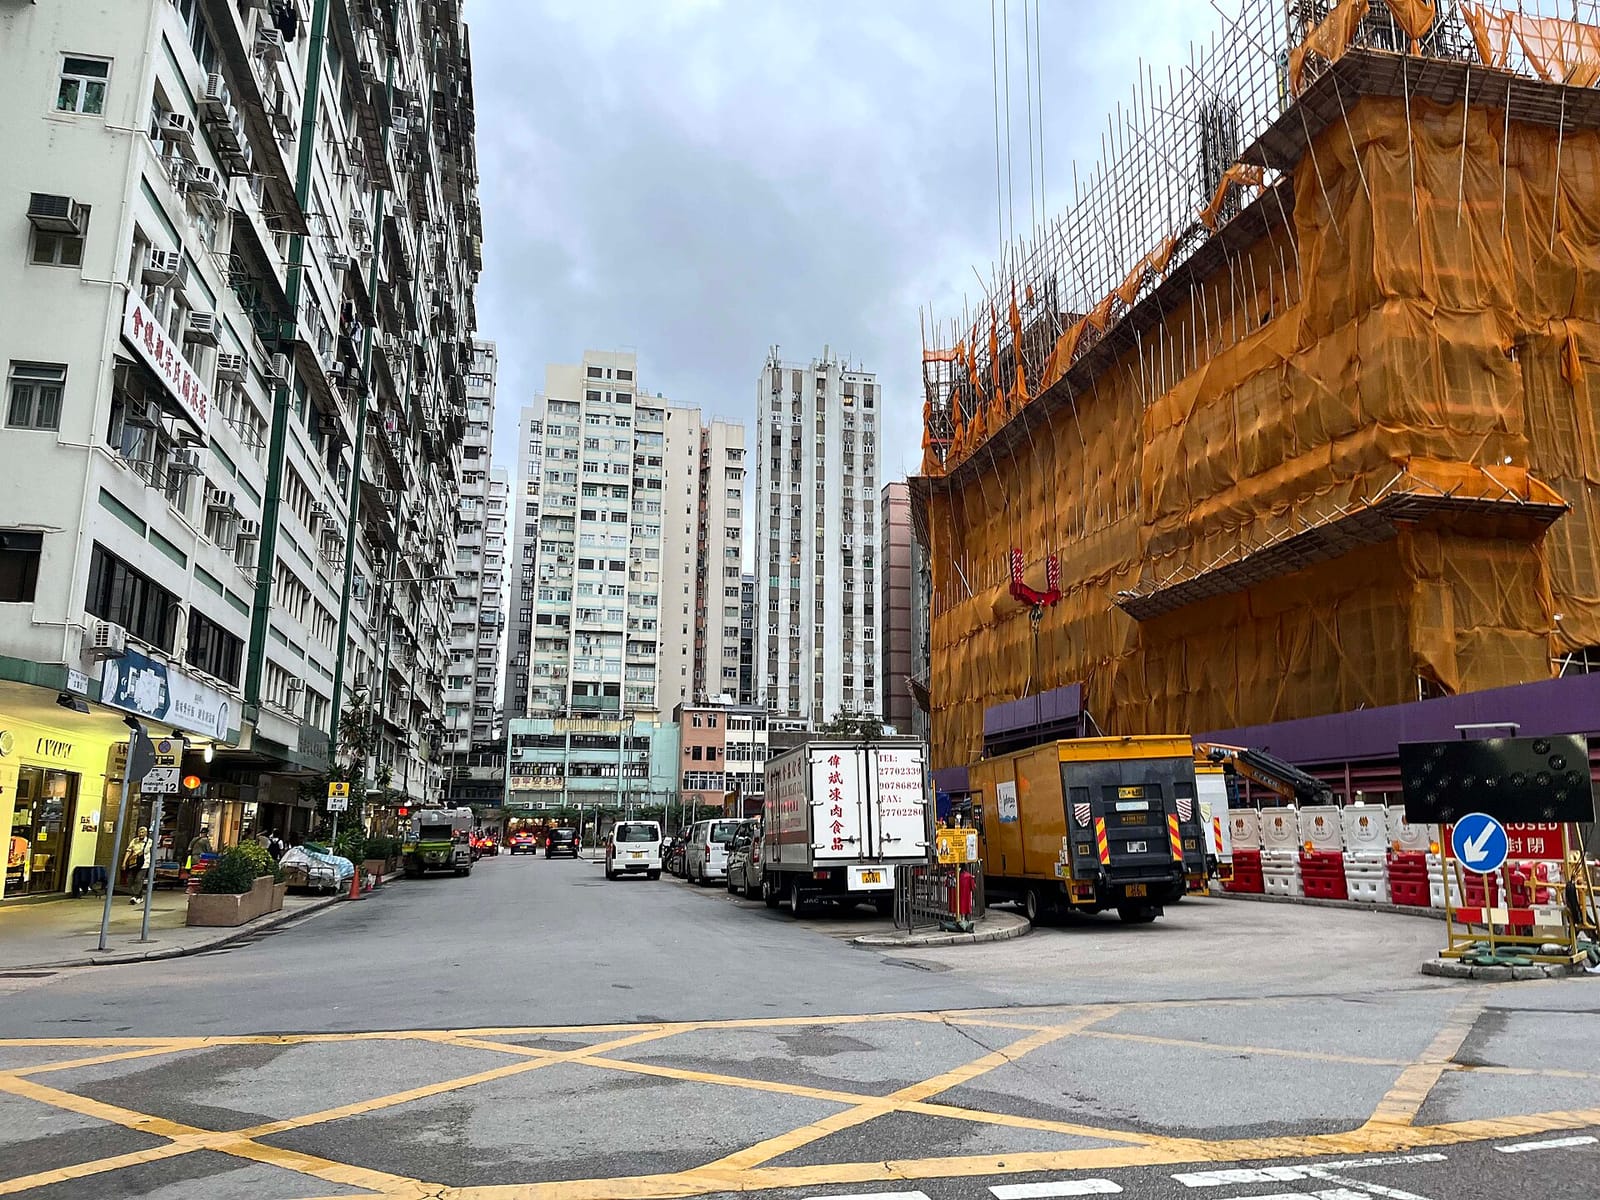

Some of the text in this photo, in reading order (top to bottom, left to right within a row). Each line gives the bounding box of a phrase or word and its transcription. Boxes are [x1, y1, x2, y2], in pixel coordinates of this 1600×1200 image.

[166, 769, 173, 778] 7
[879, 767, 921, 776] 27702339
[165, 783, 177, 792] 12
[879, 782, 923, 790] 90786820
[881, 795, 902, 803] FAX:
[880, 808, 923, 817] 27702280
[1503, 822, 1558, 831] LOSED
